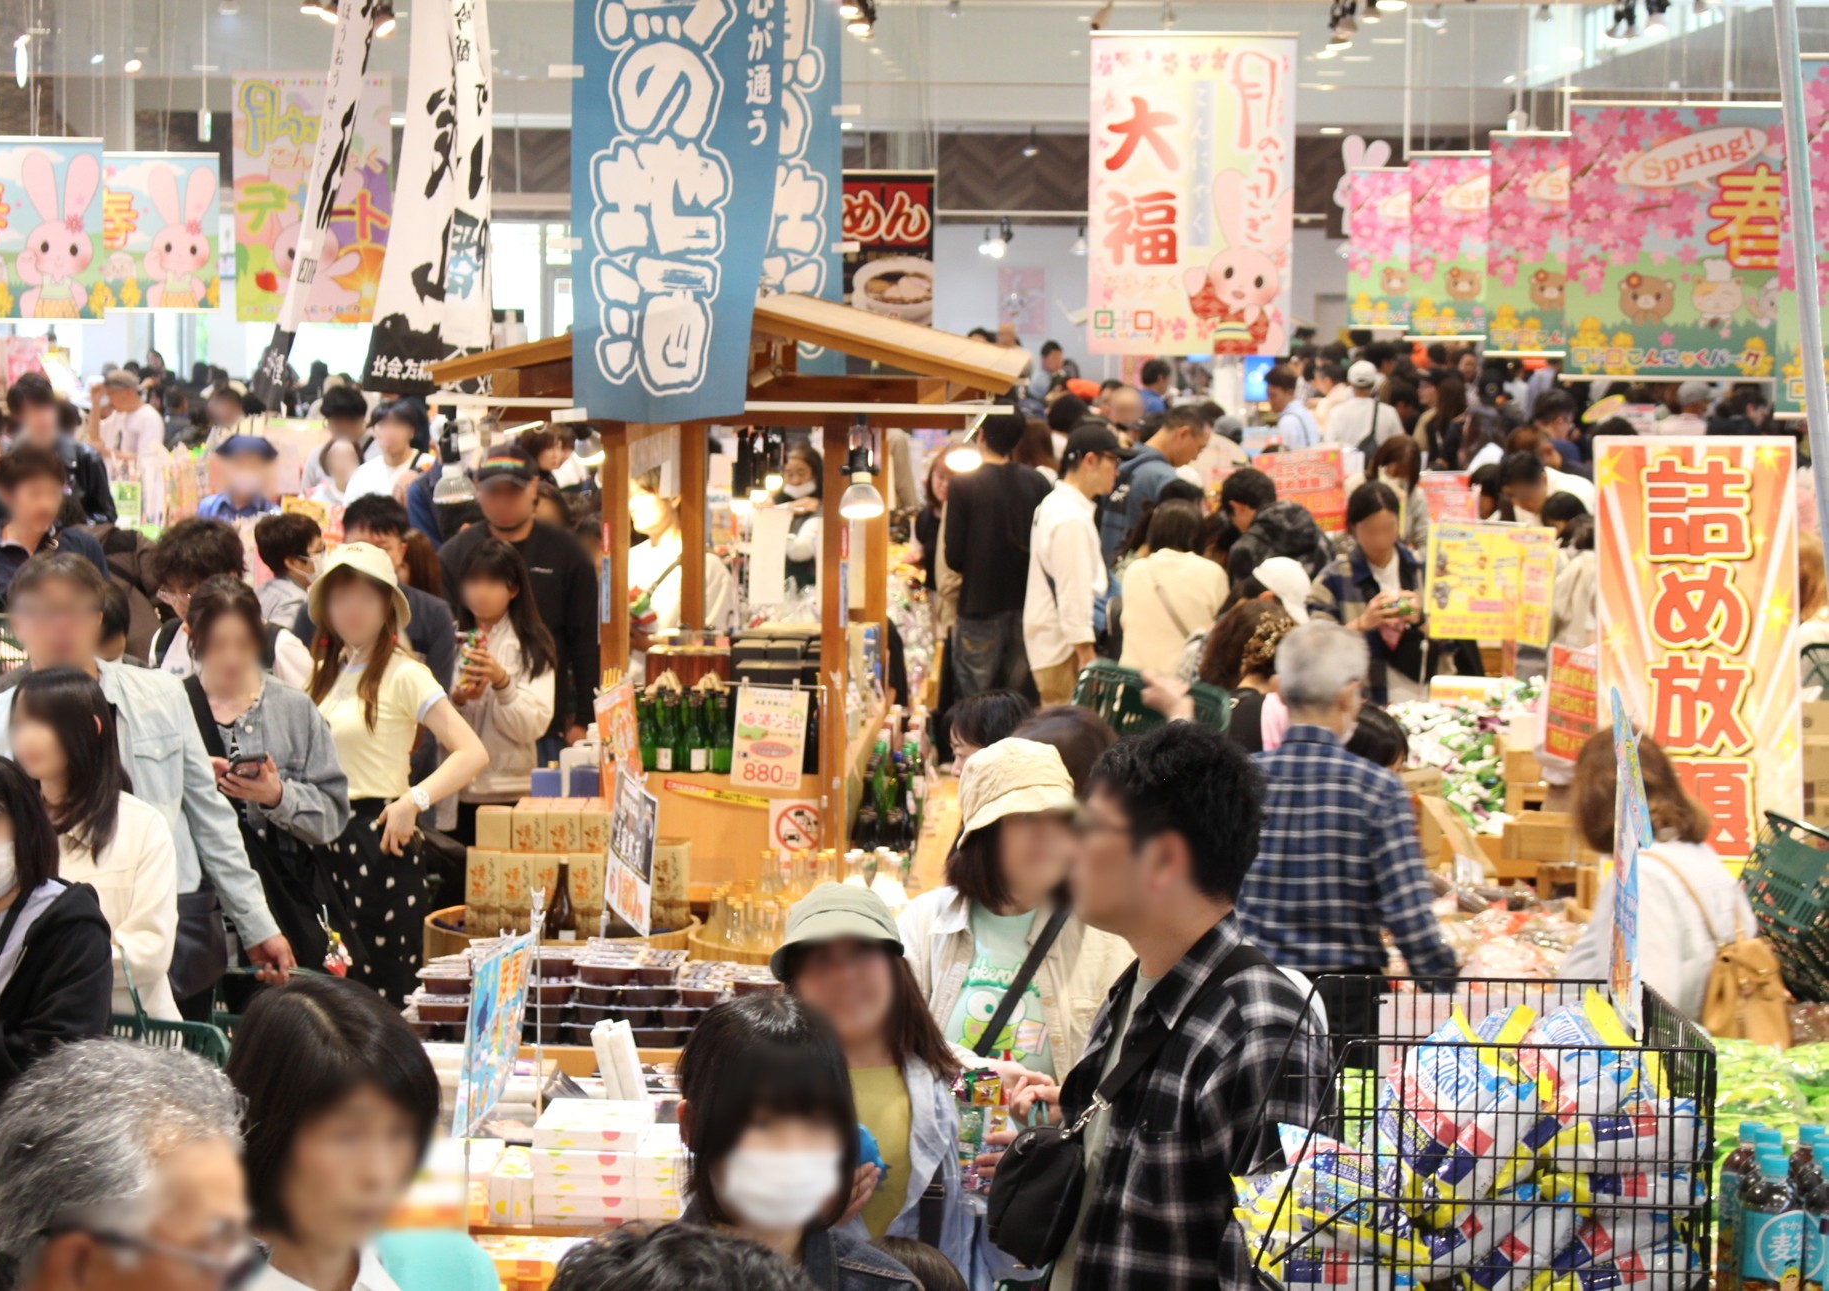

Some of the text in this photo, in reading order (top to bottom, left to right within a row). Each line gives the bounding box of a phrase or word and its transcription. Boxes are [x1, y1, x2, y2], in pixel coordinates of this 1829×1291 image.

[1103, 95, 1180, 266] 大福
[1641, 128, 1758, 183] Spring!
[1706, 162, 1783, 270] 春
[743, 762, 797, 785] 880円
[1767, 1232, 1817, 1263] 麦茶
